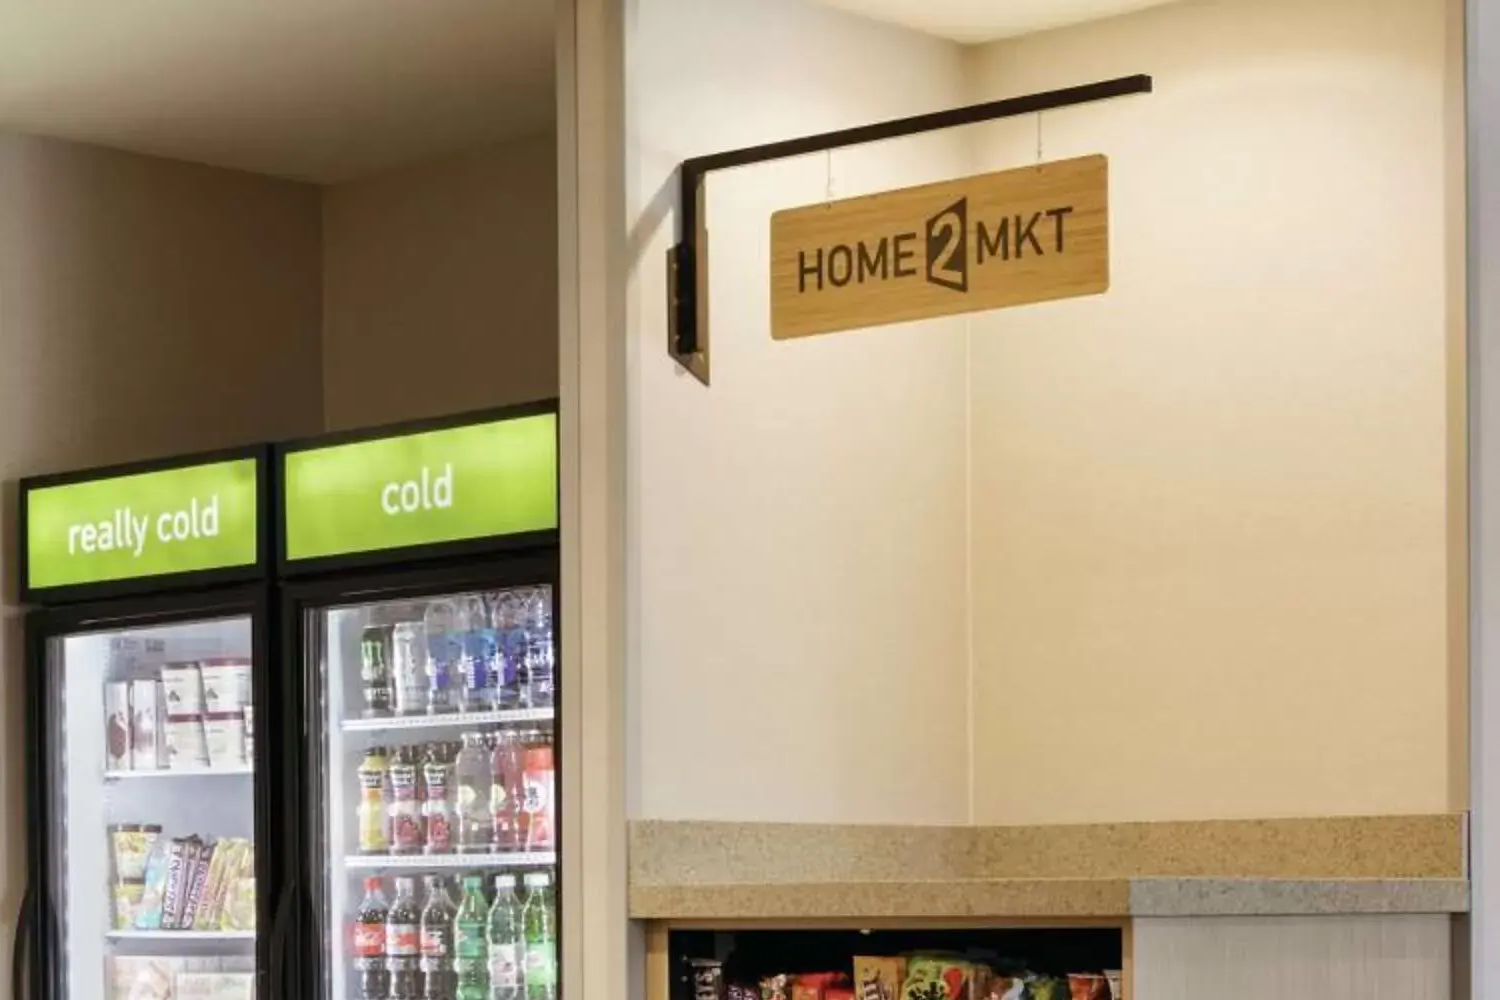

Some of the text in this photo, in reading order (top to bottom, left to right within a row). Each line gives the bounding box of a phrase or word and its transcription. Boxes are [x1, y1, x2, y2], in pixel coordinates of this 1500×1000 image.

[798, 232, 917, 293] HOME
[977, 206, 1073, 265] MKT
[381, 464, 453, 517] cold
[68, 495, 219, 558] really cold
